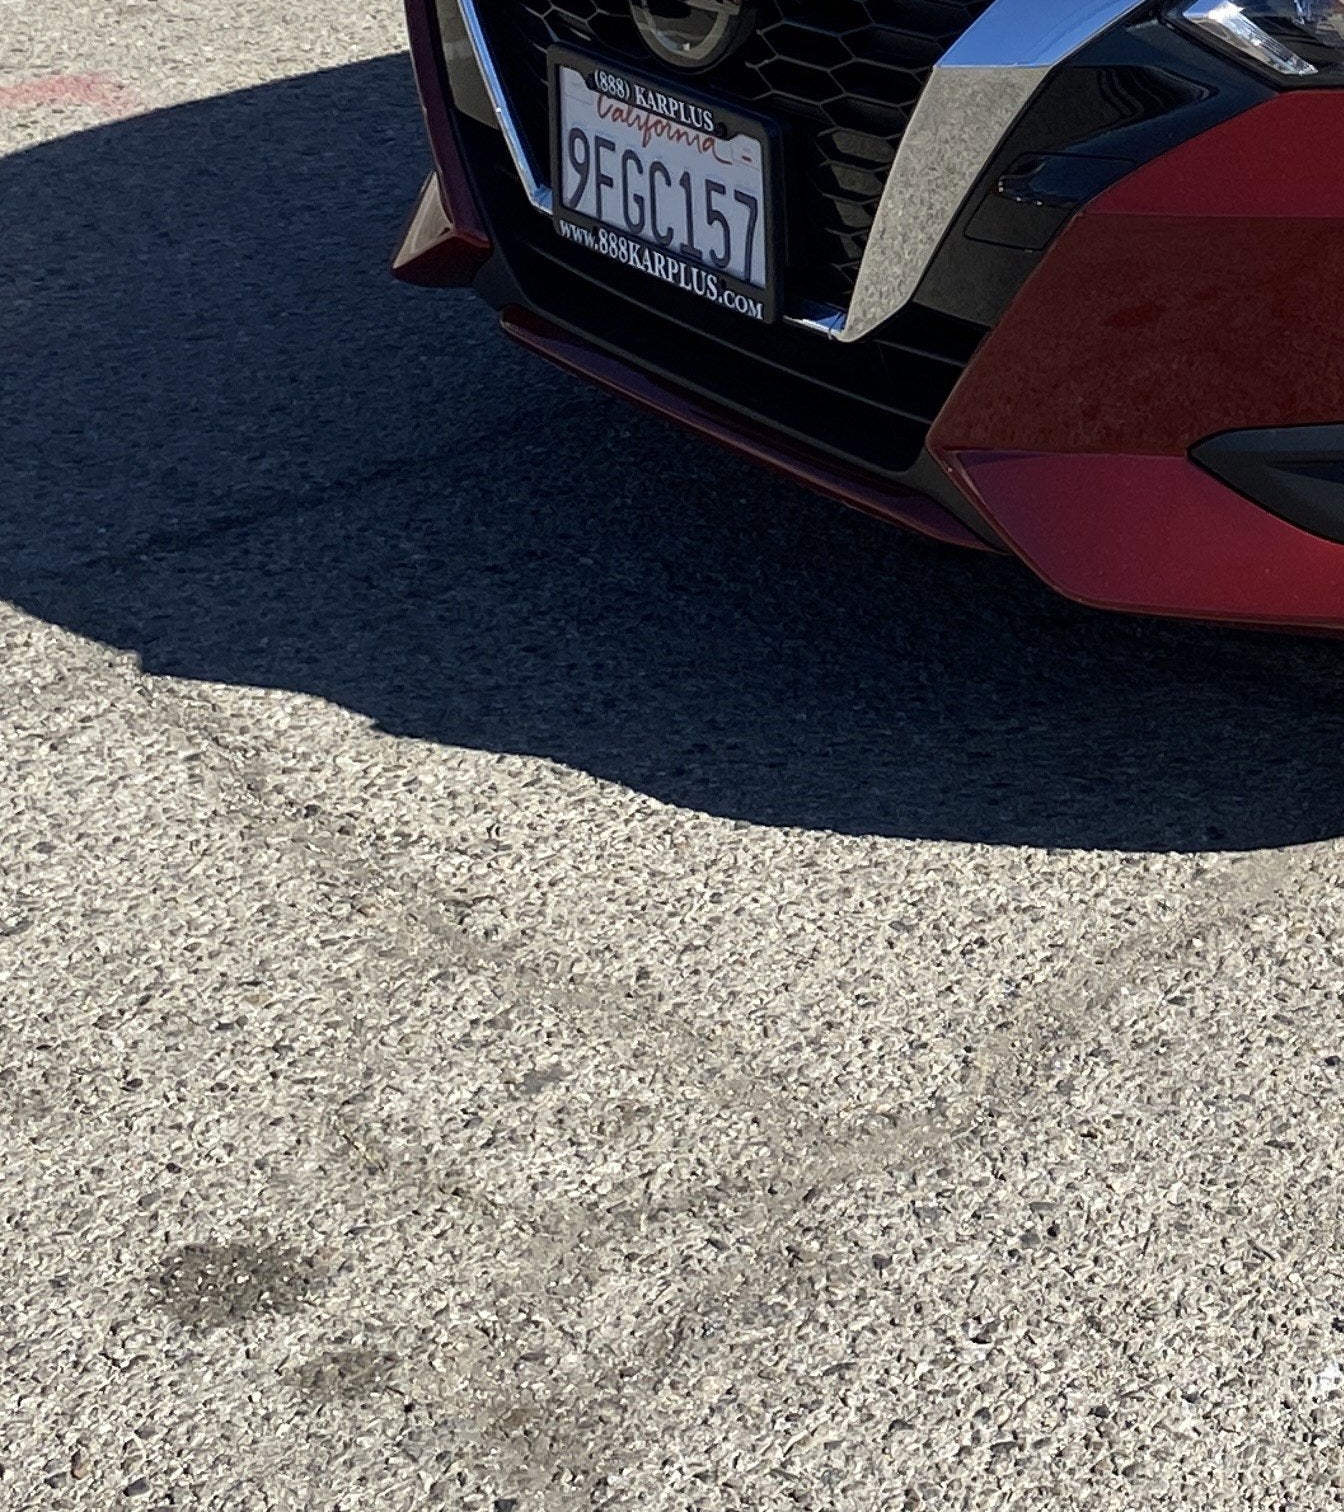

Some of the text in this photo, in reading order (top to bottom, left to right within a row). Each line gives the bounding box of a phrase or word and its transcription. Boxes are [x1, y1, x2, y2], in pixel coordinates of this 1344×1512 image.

[594, 69, 714, 132] (888) KARPLUS
[568, 127, 758, 281] 9FGC157
